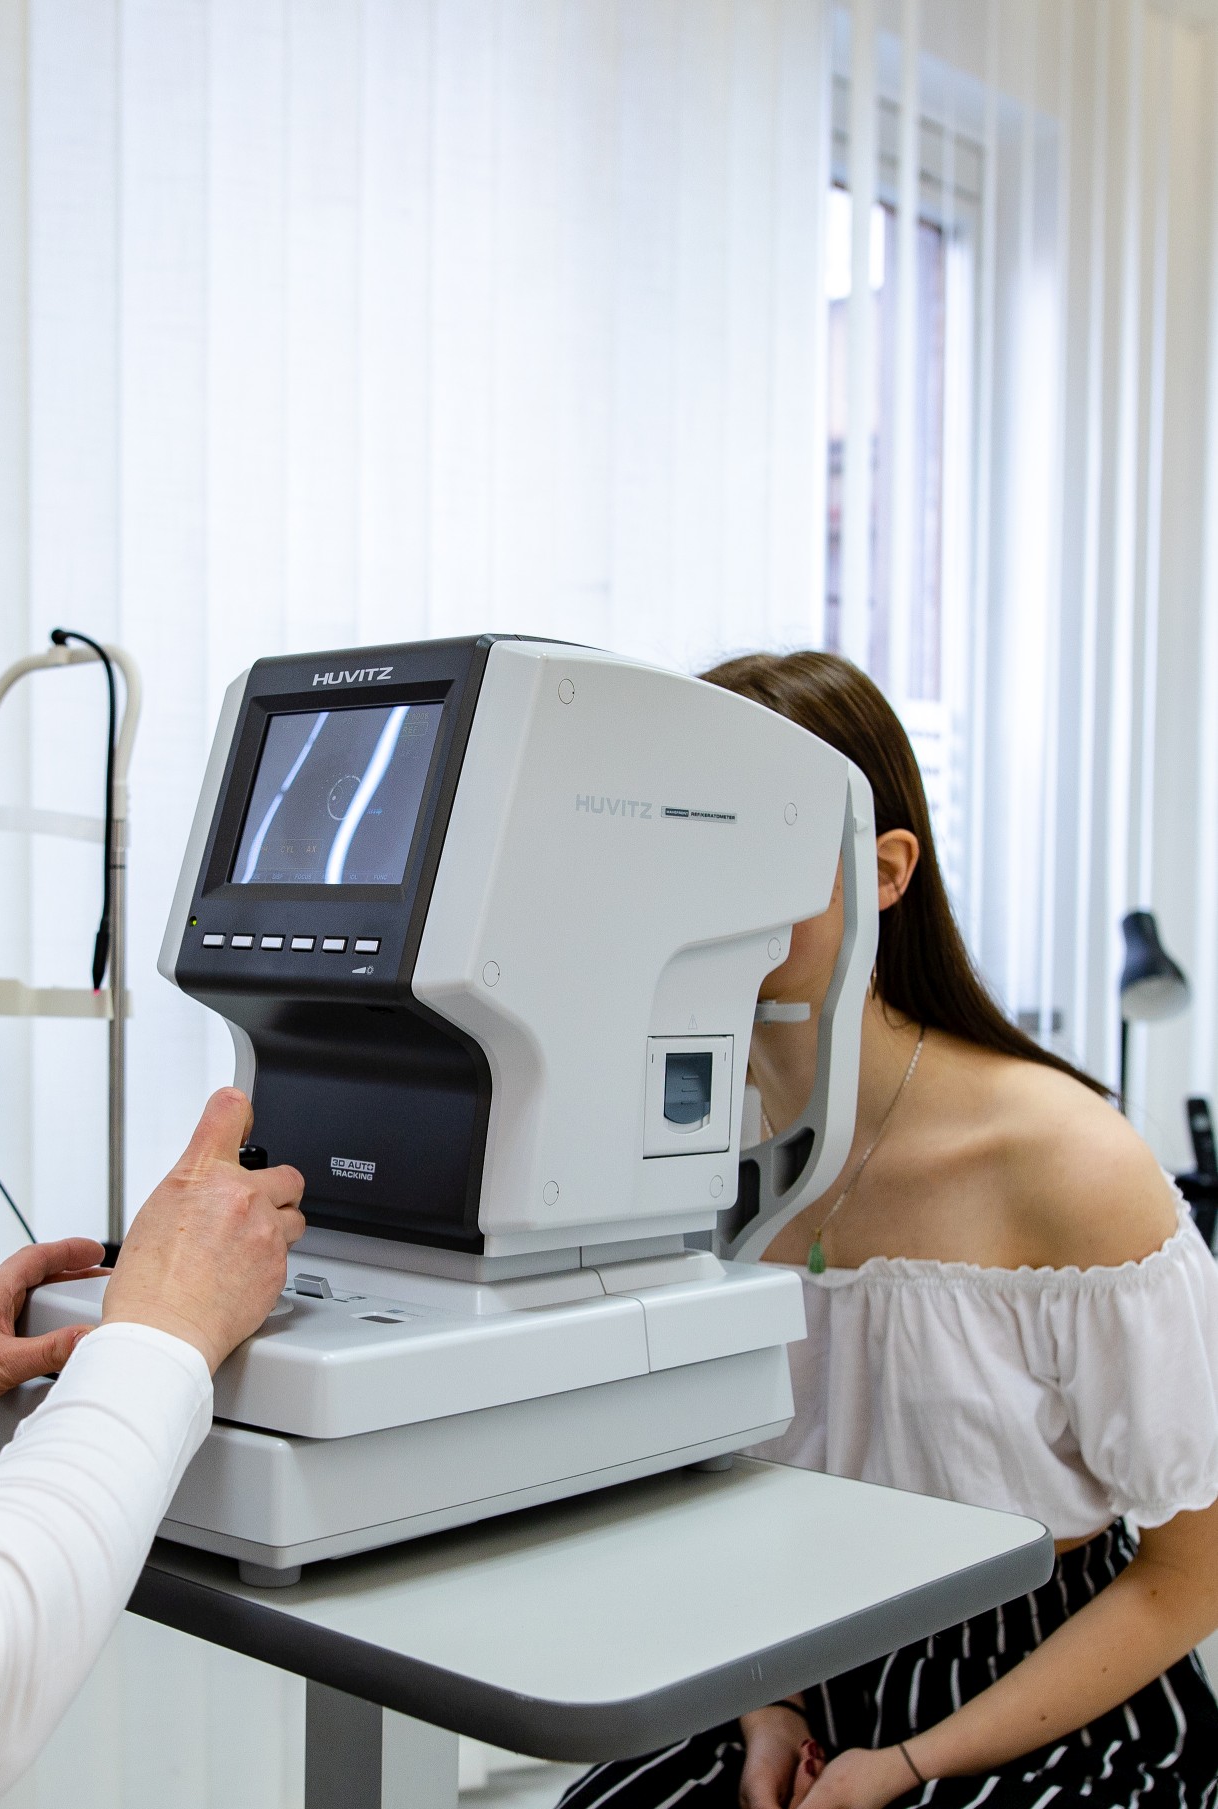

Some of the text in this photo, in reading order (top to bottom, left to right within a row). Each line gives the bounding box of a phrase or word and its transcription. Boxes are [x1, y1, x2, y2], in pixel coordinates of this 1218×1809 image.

[312, 666, 394, 686] HUVITZ
[575, 794, 653, 819] HUVITZ
[332, 1158, 374, 1171] 3D AUTO
[331, 1168, 373, 1181] TRACKING
